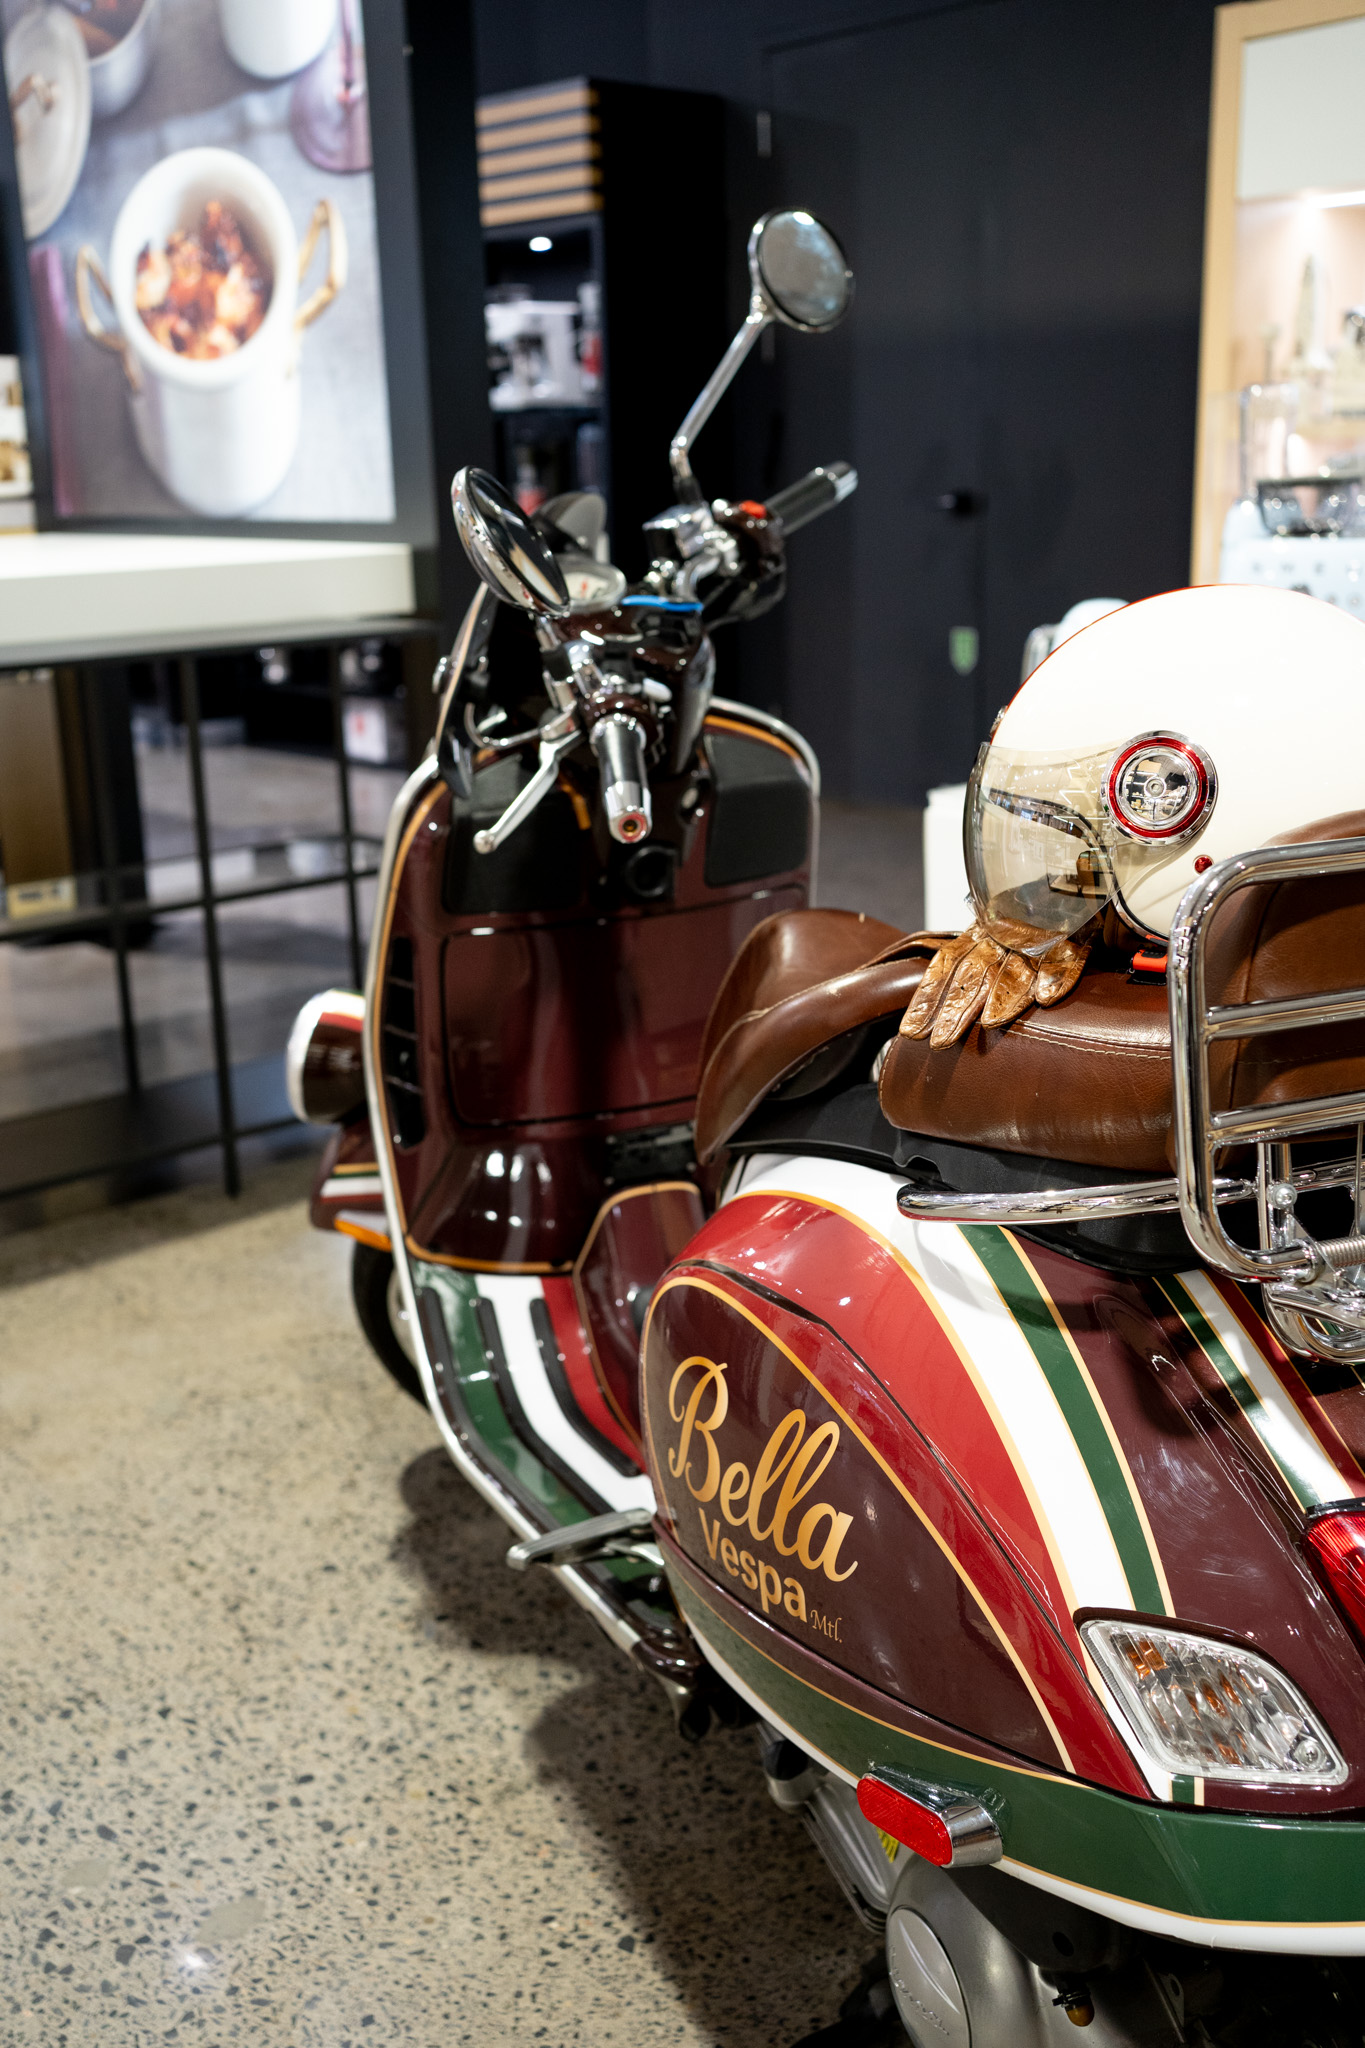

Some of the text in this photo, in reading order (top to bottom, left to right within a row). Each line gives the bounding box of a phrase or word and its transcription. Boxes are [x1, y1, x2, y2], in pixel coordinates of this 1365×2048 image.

[669, 1356, 858, 1582] Bella
[699, 1508, 843, 1643] Vespa Mtl.
